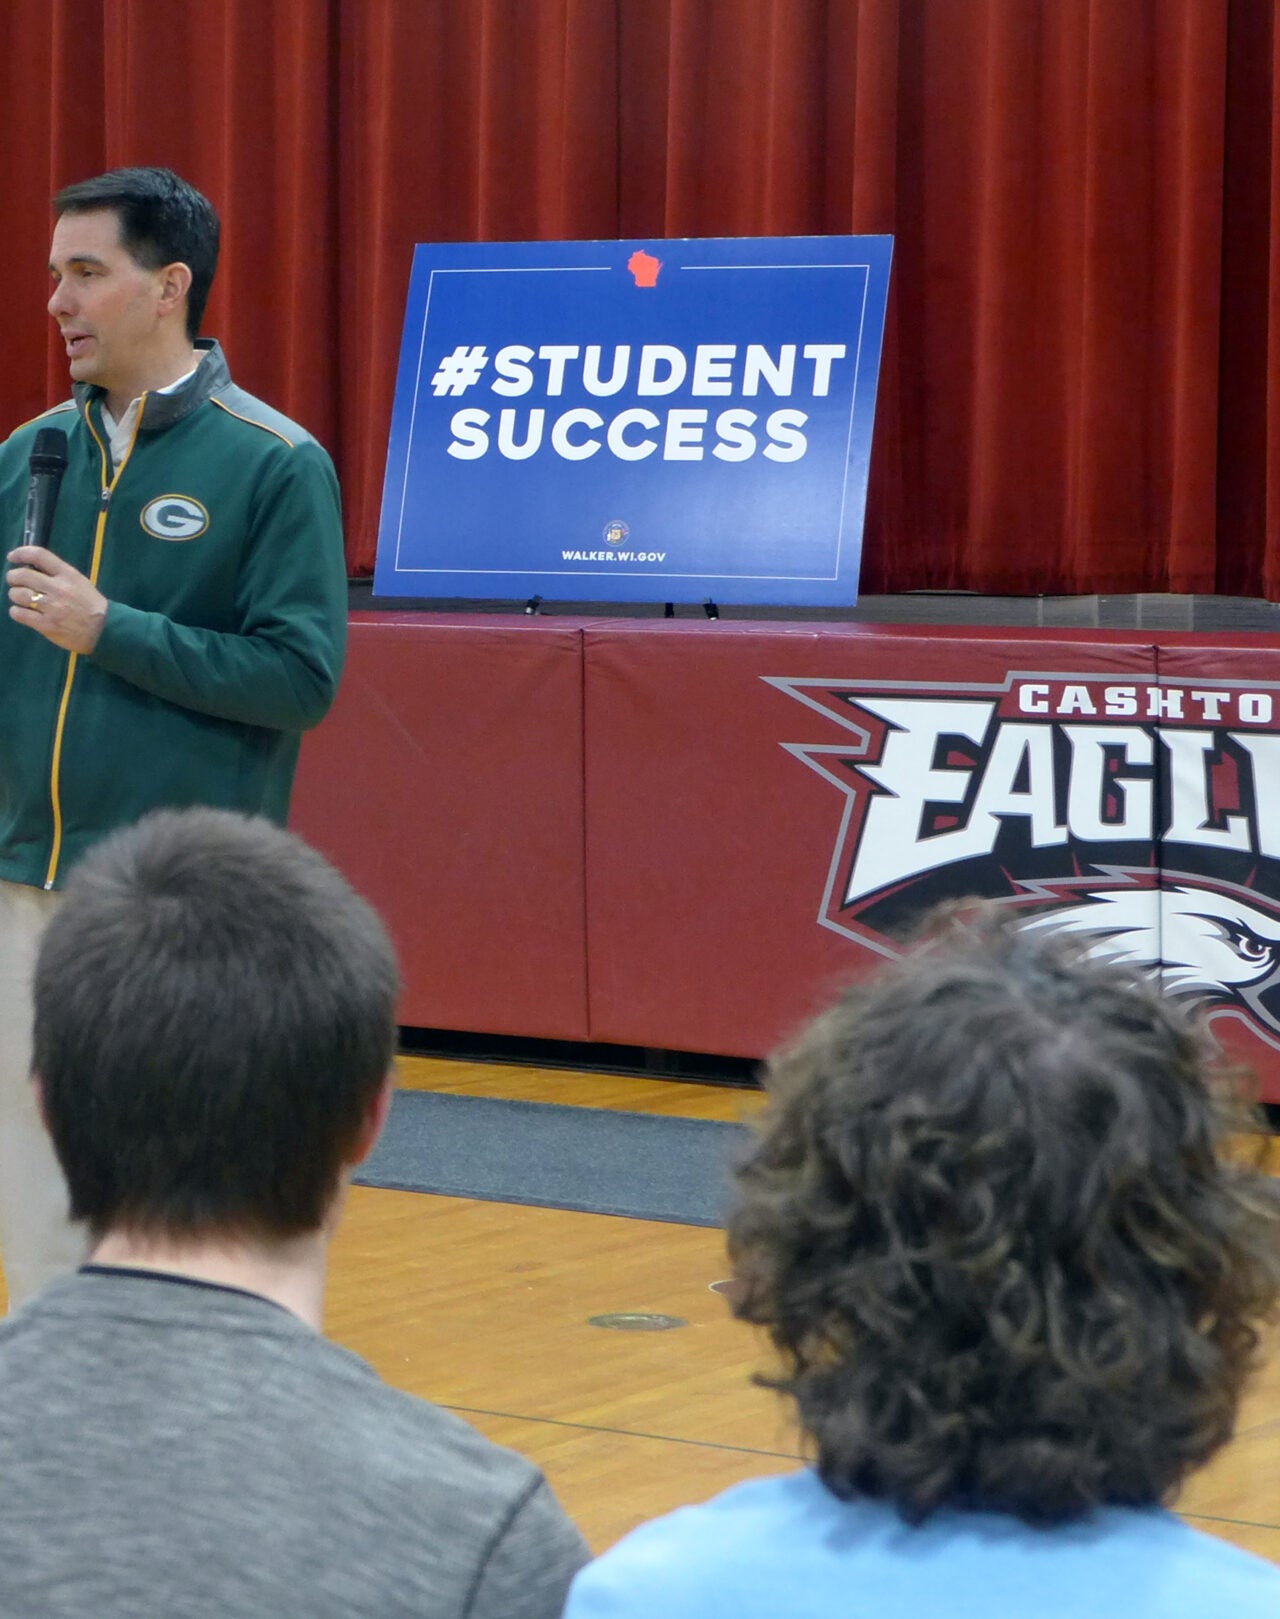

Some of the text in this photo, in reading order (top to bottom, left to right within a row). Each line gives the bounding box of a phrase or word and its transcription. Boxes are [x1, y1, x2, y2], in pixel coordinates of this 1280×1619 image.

[431, 344, 846, 397] #STUDENT
[446, 408, 808, 462] SUCCESS
[144, 498, 204, 537] G
[562, 550, 666, 562] WALKER.WI.GOV
